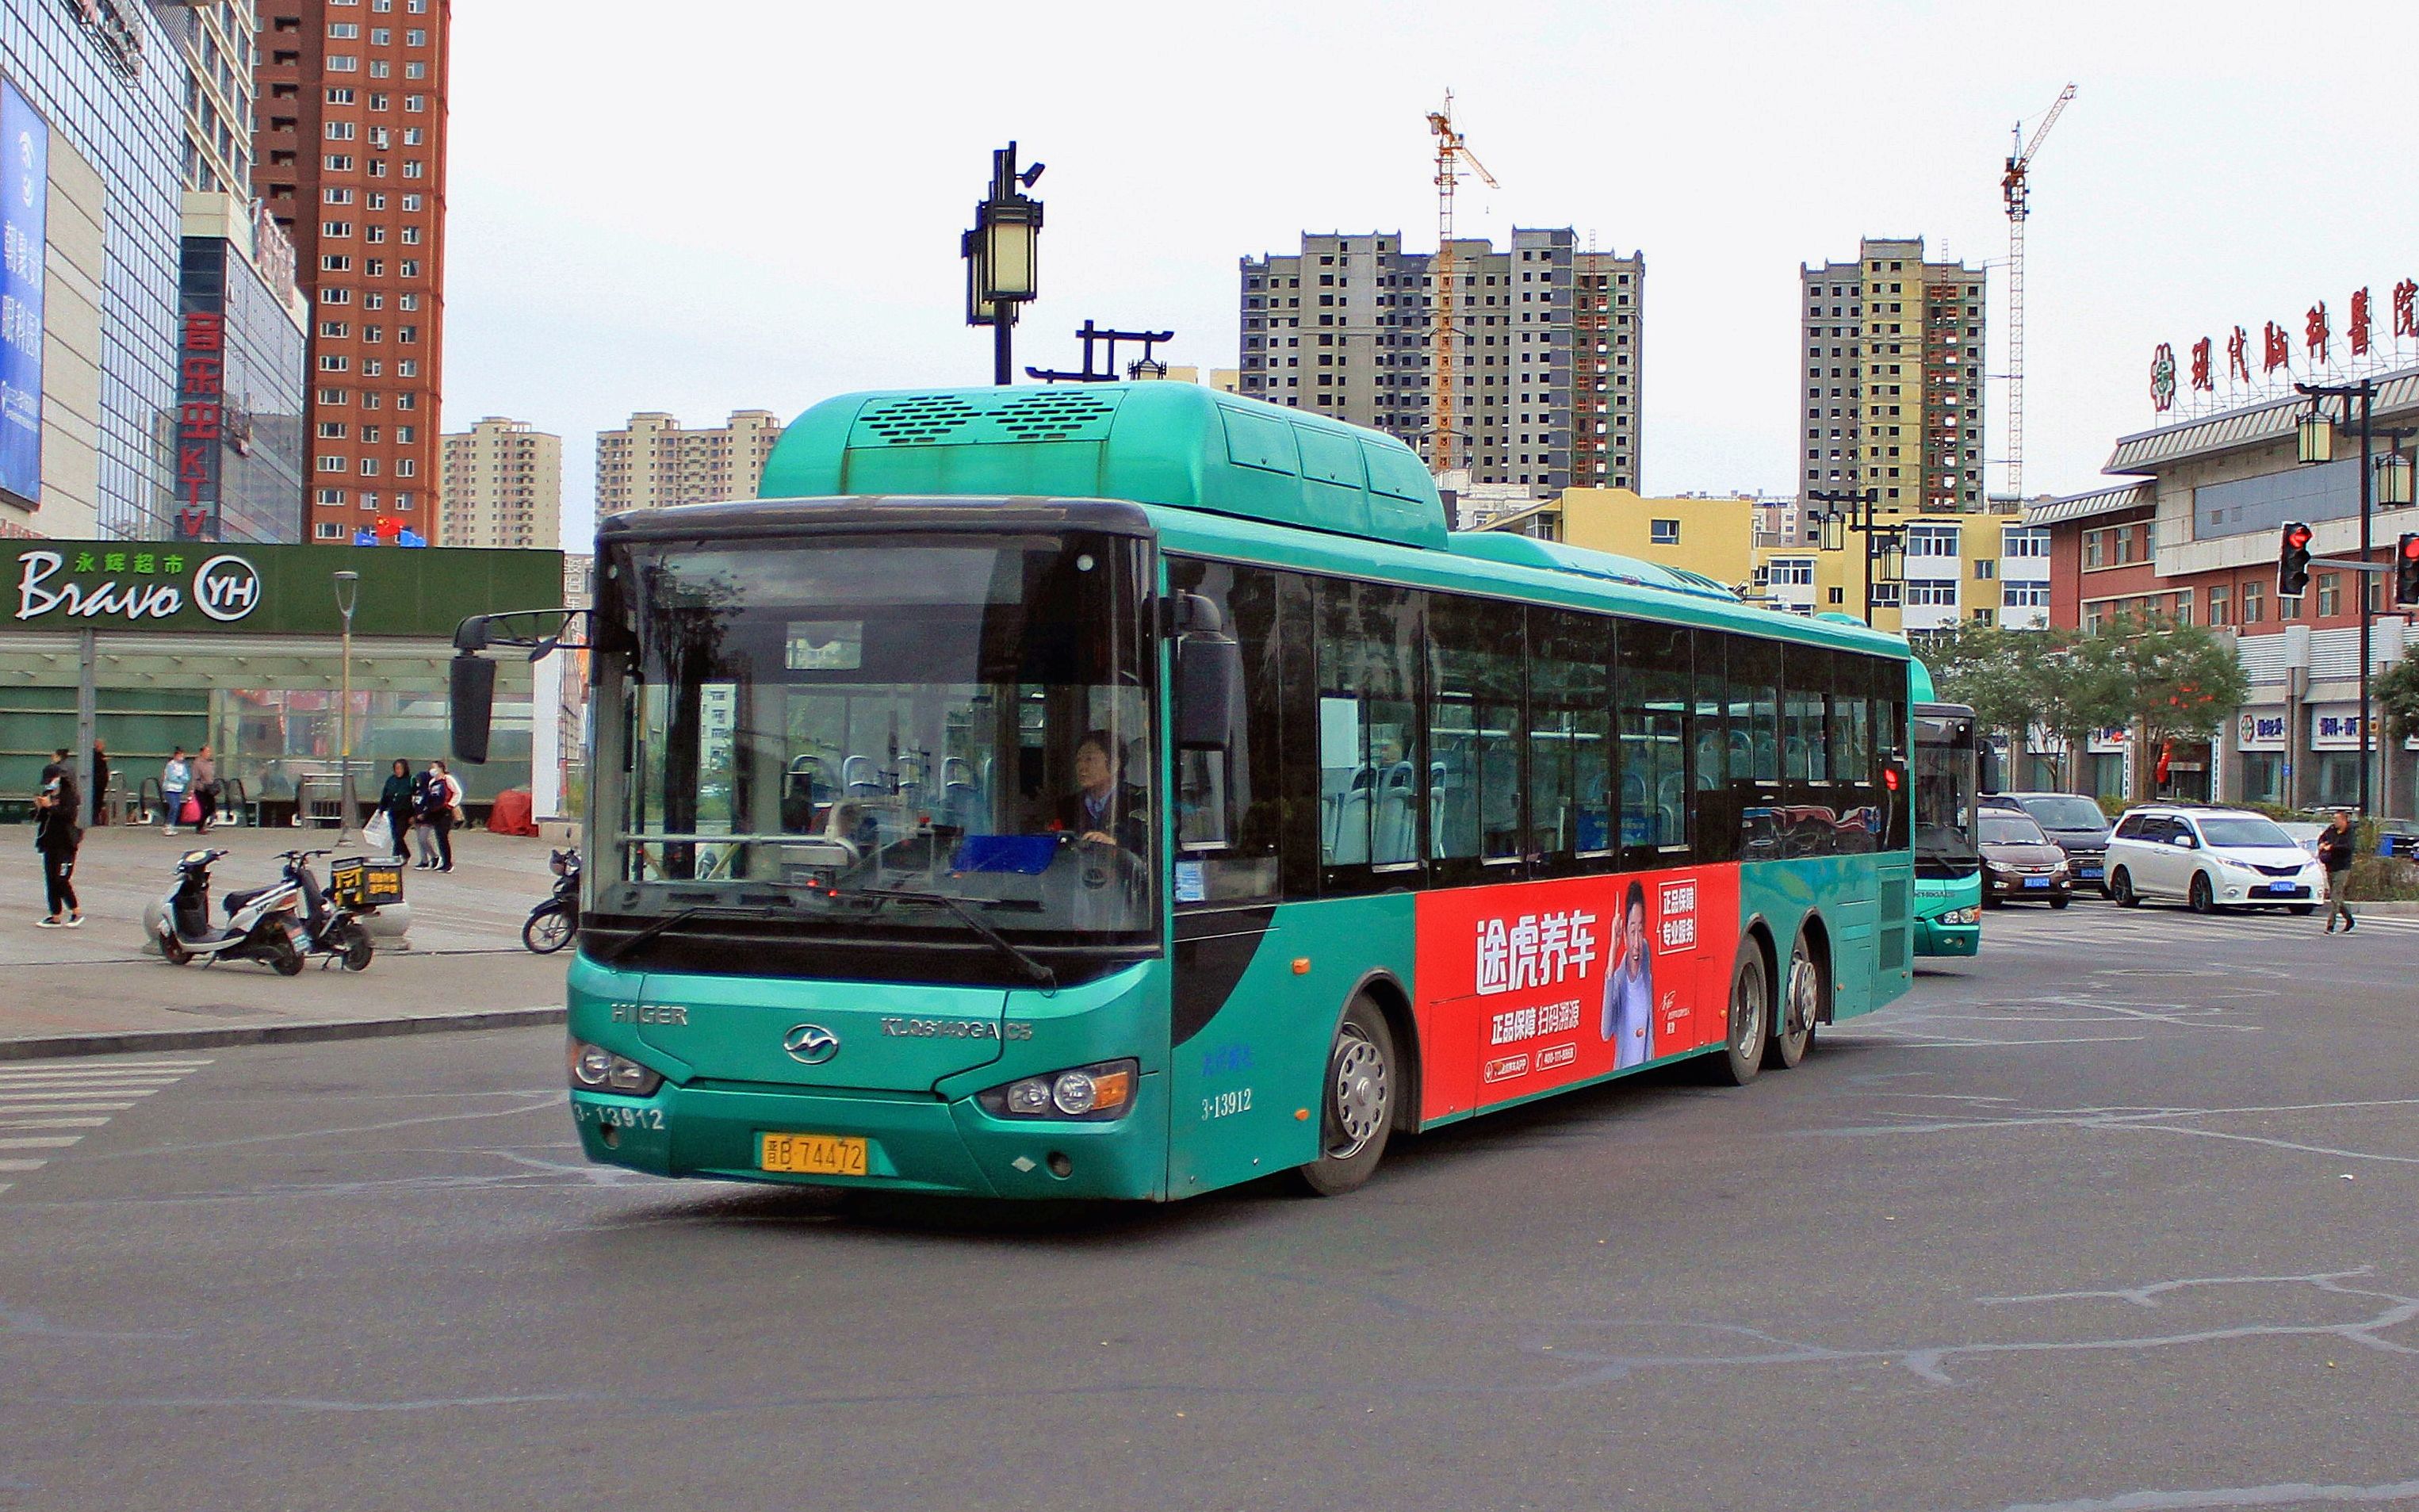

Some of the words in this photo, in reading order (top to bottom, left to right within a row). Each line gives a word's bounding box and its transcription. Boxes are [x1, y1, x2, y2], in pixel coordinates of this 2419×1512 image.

[74, 552, 184, 573] 永辉超市
[15, 551, 183, 620] Bravo
[207, 576, 254, 607] YH
[1663, 886, 1694, 914] 正品保障
[1663, 918, 1694, 947] 专业服务
[1476, 909, 1596, 995] 途虎养车
[611, 1003, 687, 1026] HIGER
[1491, 1007, 1537, 1045] 正品保障
